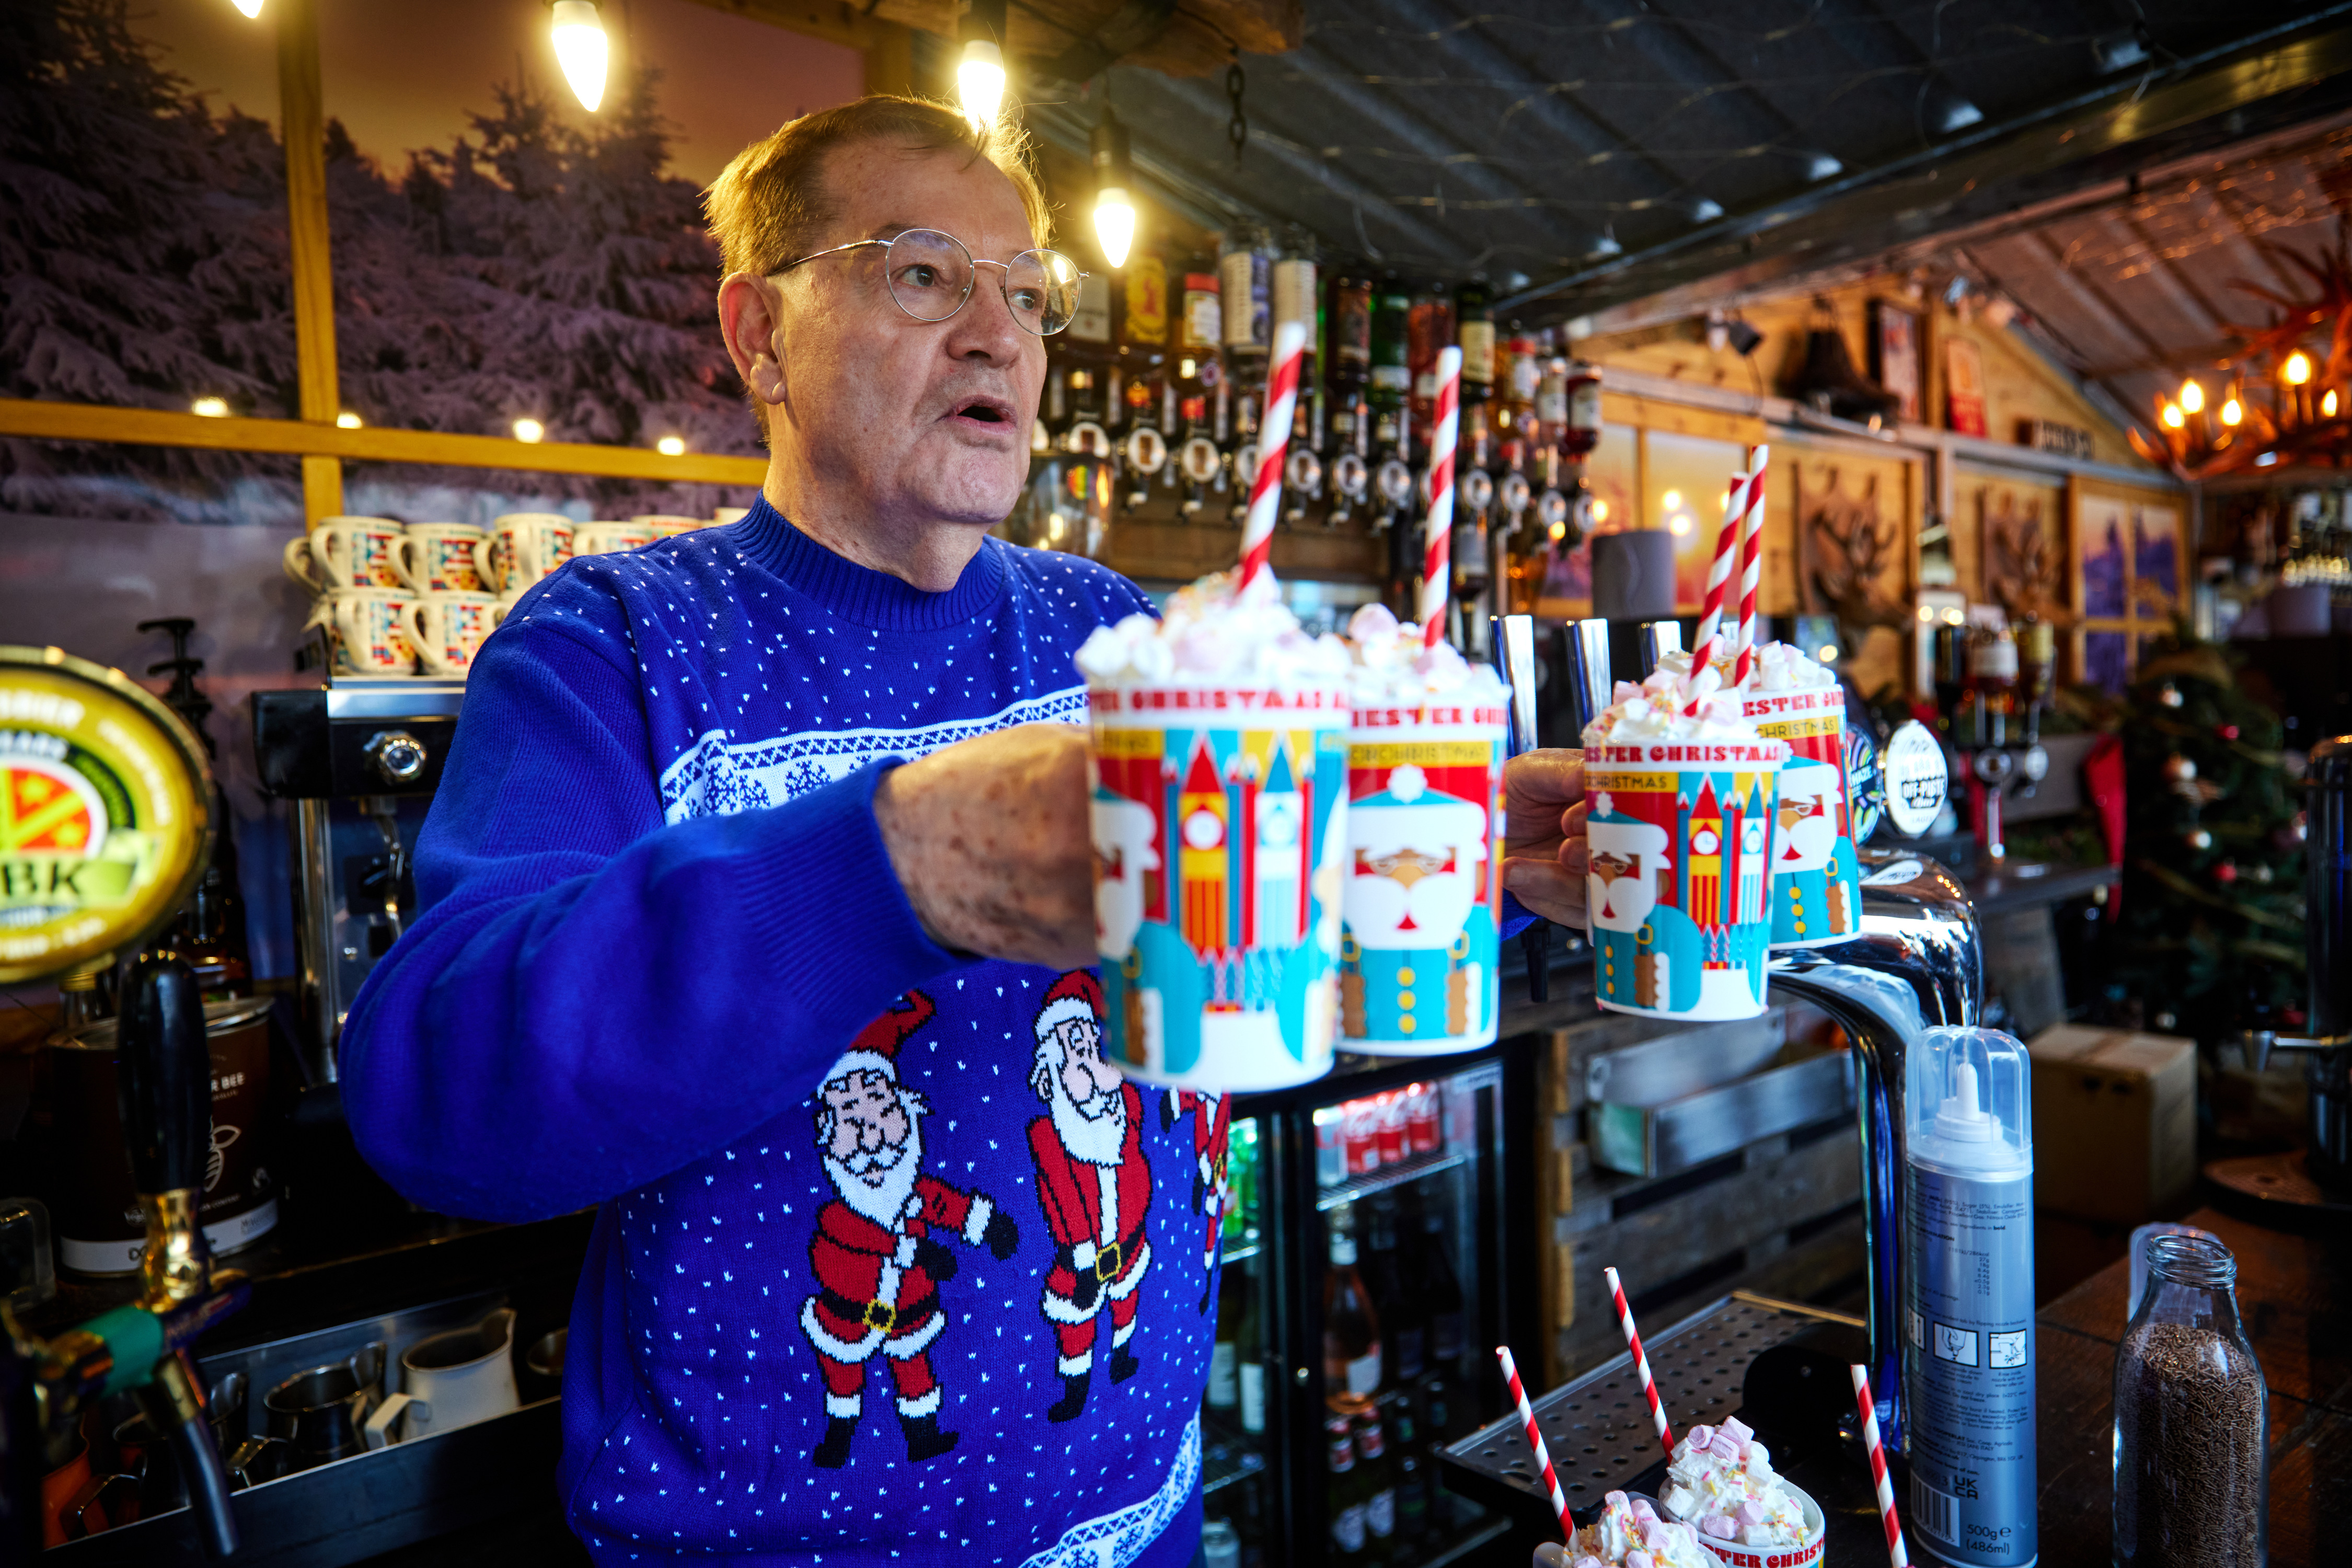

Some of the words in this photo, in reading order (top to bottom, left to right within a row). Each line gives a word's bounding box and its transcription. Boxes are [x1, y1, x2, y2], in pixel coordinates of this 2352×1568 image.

[1650, 745, 1779, 763] CHRISTMAS
[1954, 1475, 1978, 1490] UK
[1954, 1486, 1979, 1500] CA
[1967, 1524, 1998, 1541] 500g
[1966, 1539, 2010, 1555] (486ml)
